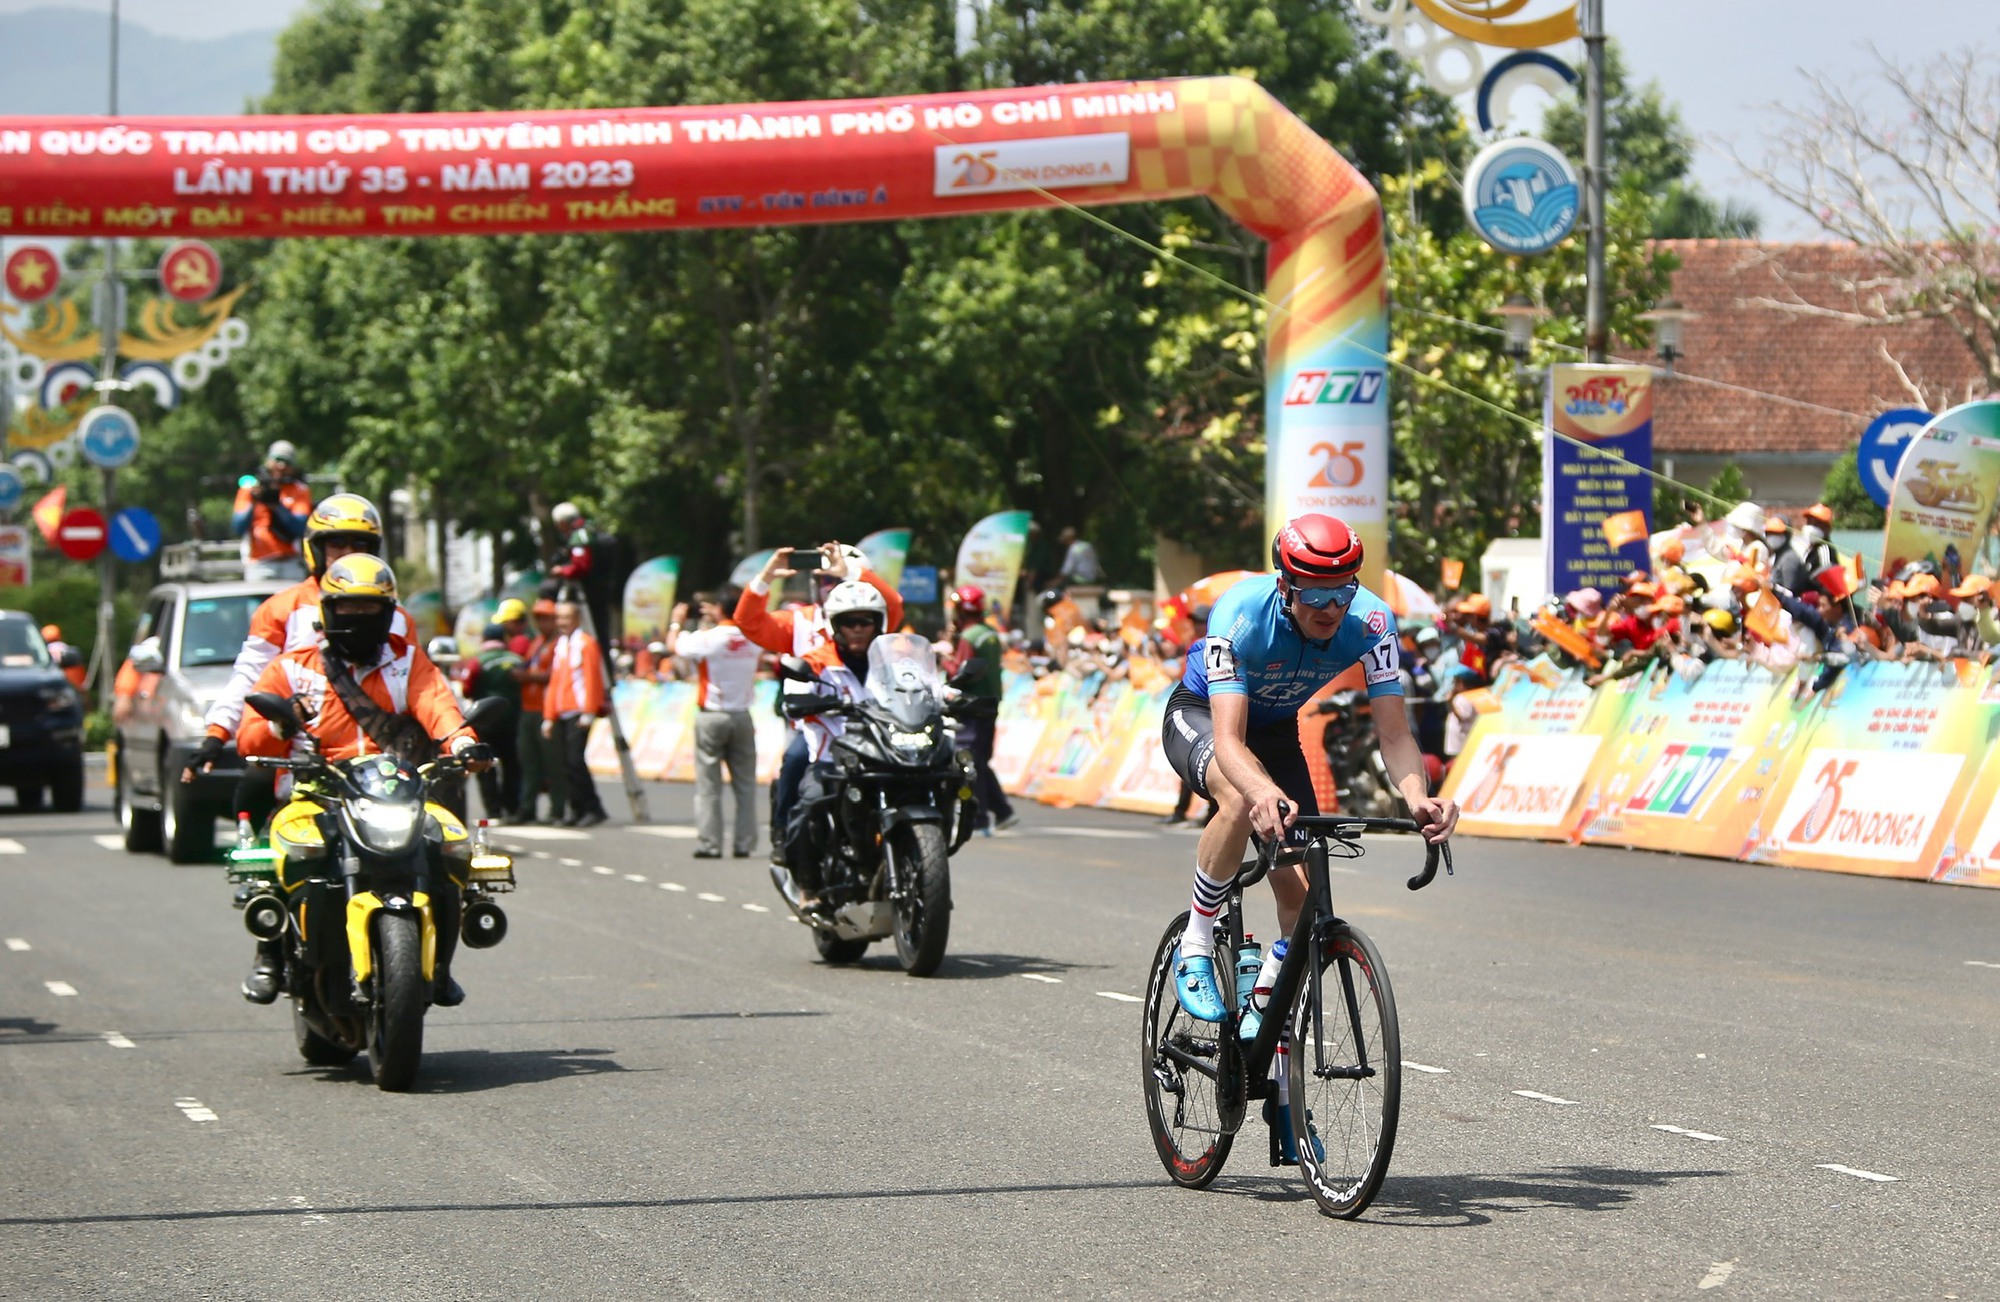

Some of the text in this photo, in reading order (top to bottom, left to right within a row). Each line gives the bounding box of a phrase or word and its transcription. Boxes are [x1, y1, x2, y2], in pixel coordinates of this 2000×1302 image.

[40, 125, 153, 155] QUỐC
[161, 130, 297, 154] TRANH
[306, 124, 391, 153] CÚP
[403, 120, 562, 151] TRUYỀN
[570, 117, 673, 147] HÌNH
[681, 113, 821, 142] THÀNH
[831, 103, 915, 136] PHỐ
[925, 101, 983, 130] HỒ
[991, 95, 1063, 125] CHÍ
[1072, 90, 1176, 119] MINH
[174, 158, 253, 195] LẦN
[262, 160, 352, 195] THỨ
[360, 167, 407, 193] 35
[440, 158, 531, 191] NĂM
[540, 160, 636, 188] 2023
[952, 151, 998, 188] 25
[1043, 162, 1094, 181] DONG
[1098, 161, 1112, 176] A
[104, 202, 177, 229] MỘT
[381, 205, 435, 226] TIN
[450, 193, 548, 222] CHIẾN
[565, 190, 677, 221] THẮNG
[1285, 371, 1383, 405] HTV
[1308, 441, 1366, 488] 25
[1329, 496, 1368, 507] DONG
[1264, 672, 1282, 680] CHI
[1367, 643, 1392, 672] 17
[1622, 743, 1733, 817] HTV
[1787, 758, 1859, 843] 25
[1145, 929, 1183, 1048] AGNOLO
